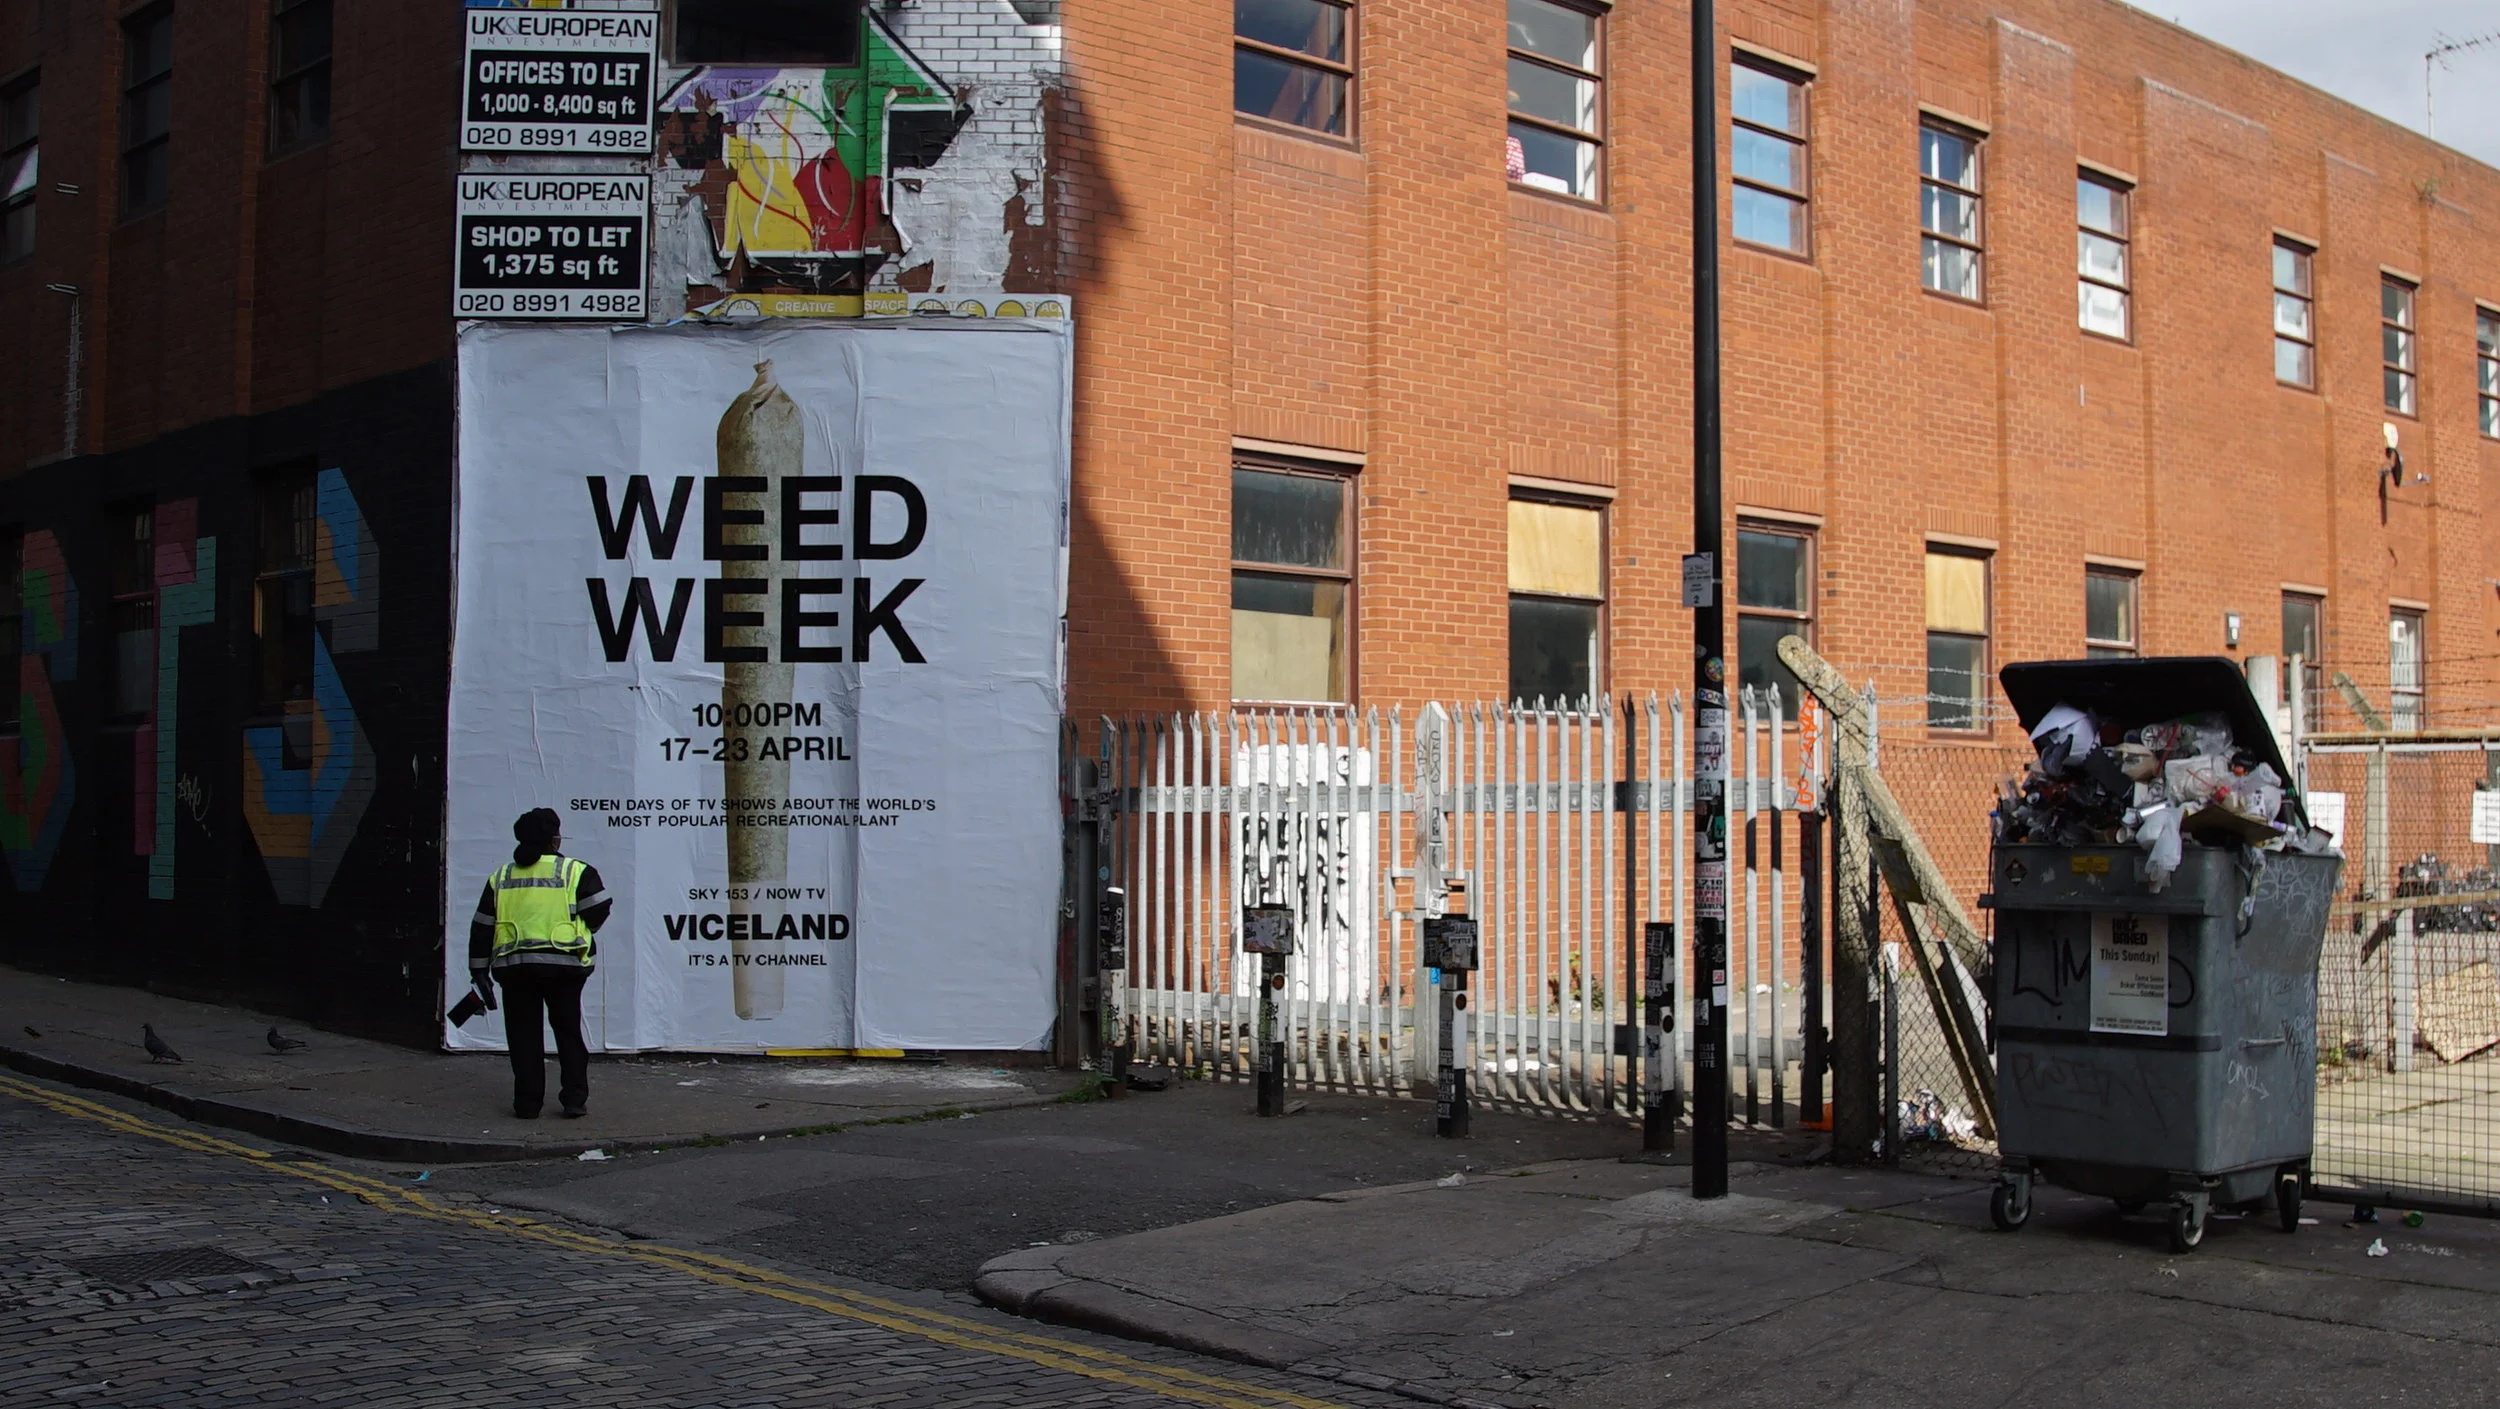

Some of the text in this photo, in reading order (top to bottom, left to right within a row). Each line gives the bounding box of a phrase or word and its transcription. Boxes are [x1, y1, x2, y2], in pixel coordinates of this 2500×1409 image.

[472, 37, 651, 48] INVESTMENTS
[479, 60, 640, 86] OFFICES TO LET
[480, 93, 530, 116] 1,000
[543, 95, 593, 117] 8,400
[597, 99, 617, 120] sq
[621, 96, 636, 115] ft
[467, 127, 647, 148] 020 8991 4982
[463, 202, 642, 212] INVESTMENTS
[471, 226, 632, 247] SHOP TO LET
[482, 254, 619, 281] 1,375 sq ft
[460, 294, 641, 312] 020 8991 4982
[775, 301, 836, 312] CREATIVE
[864, 300, 907, 311] SPACE
[586, 475, 927, 560] WEED
[586, 577, 928, 663] WEEK
[692, 703, 822, 727] 10:00PM
[759, 737, 851, 761] APRIL
[570, 798, 936, 811] SEVEN DAYS OF TV SHOWS ABOUT THE WORLD'S
[607, 814, 899, 828] MOST POPULAR RECREATIONAL PLANT
[688, 888, 718, 900] SKY
[725, 887, 749, 900] 153
[766, 888, 803, 900] NOW
[807, 888, 826, 900] TV
[663, 913, 850, 941] VICELAND
[688, 954, 828, 966] IT'S A TV CHANNEL
[2100, 949, 2160, 964] This Sunday!
